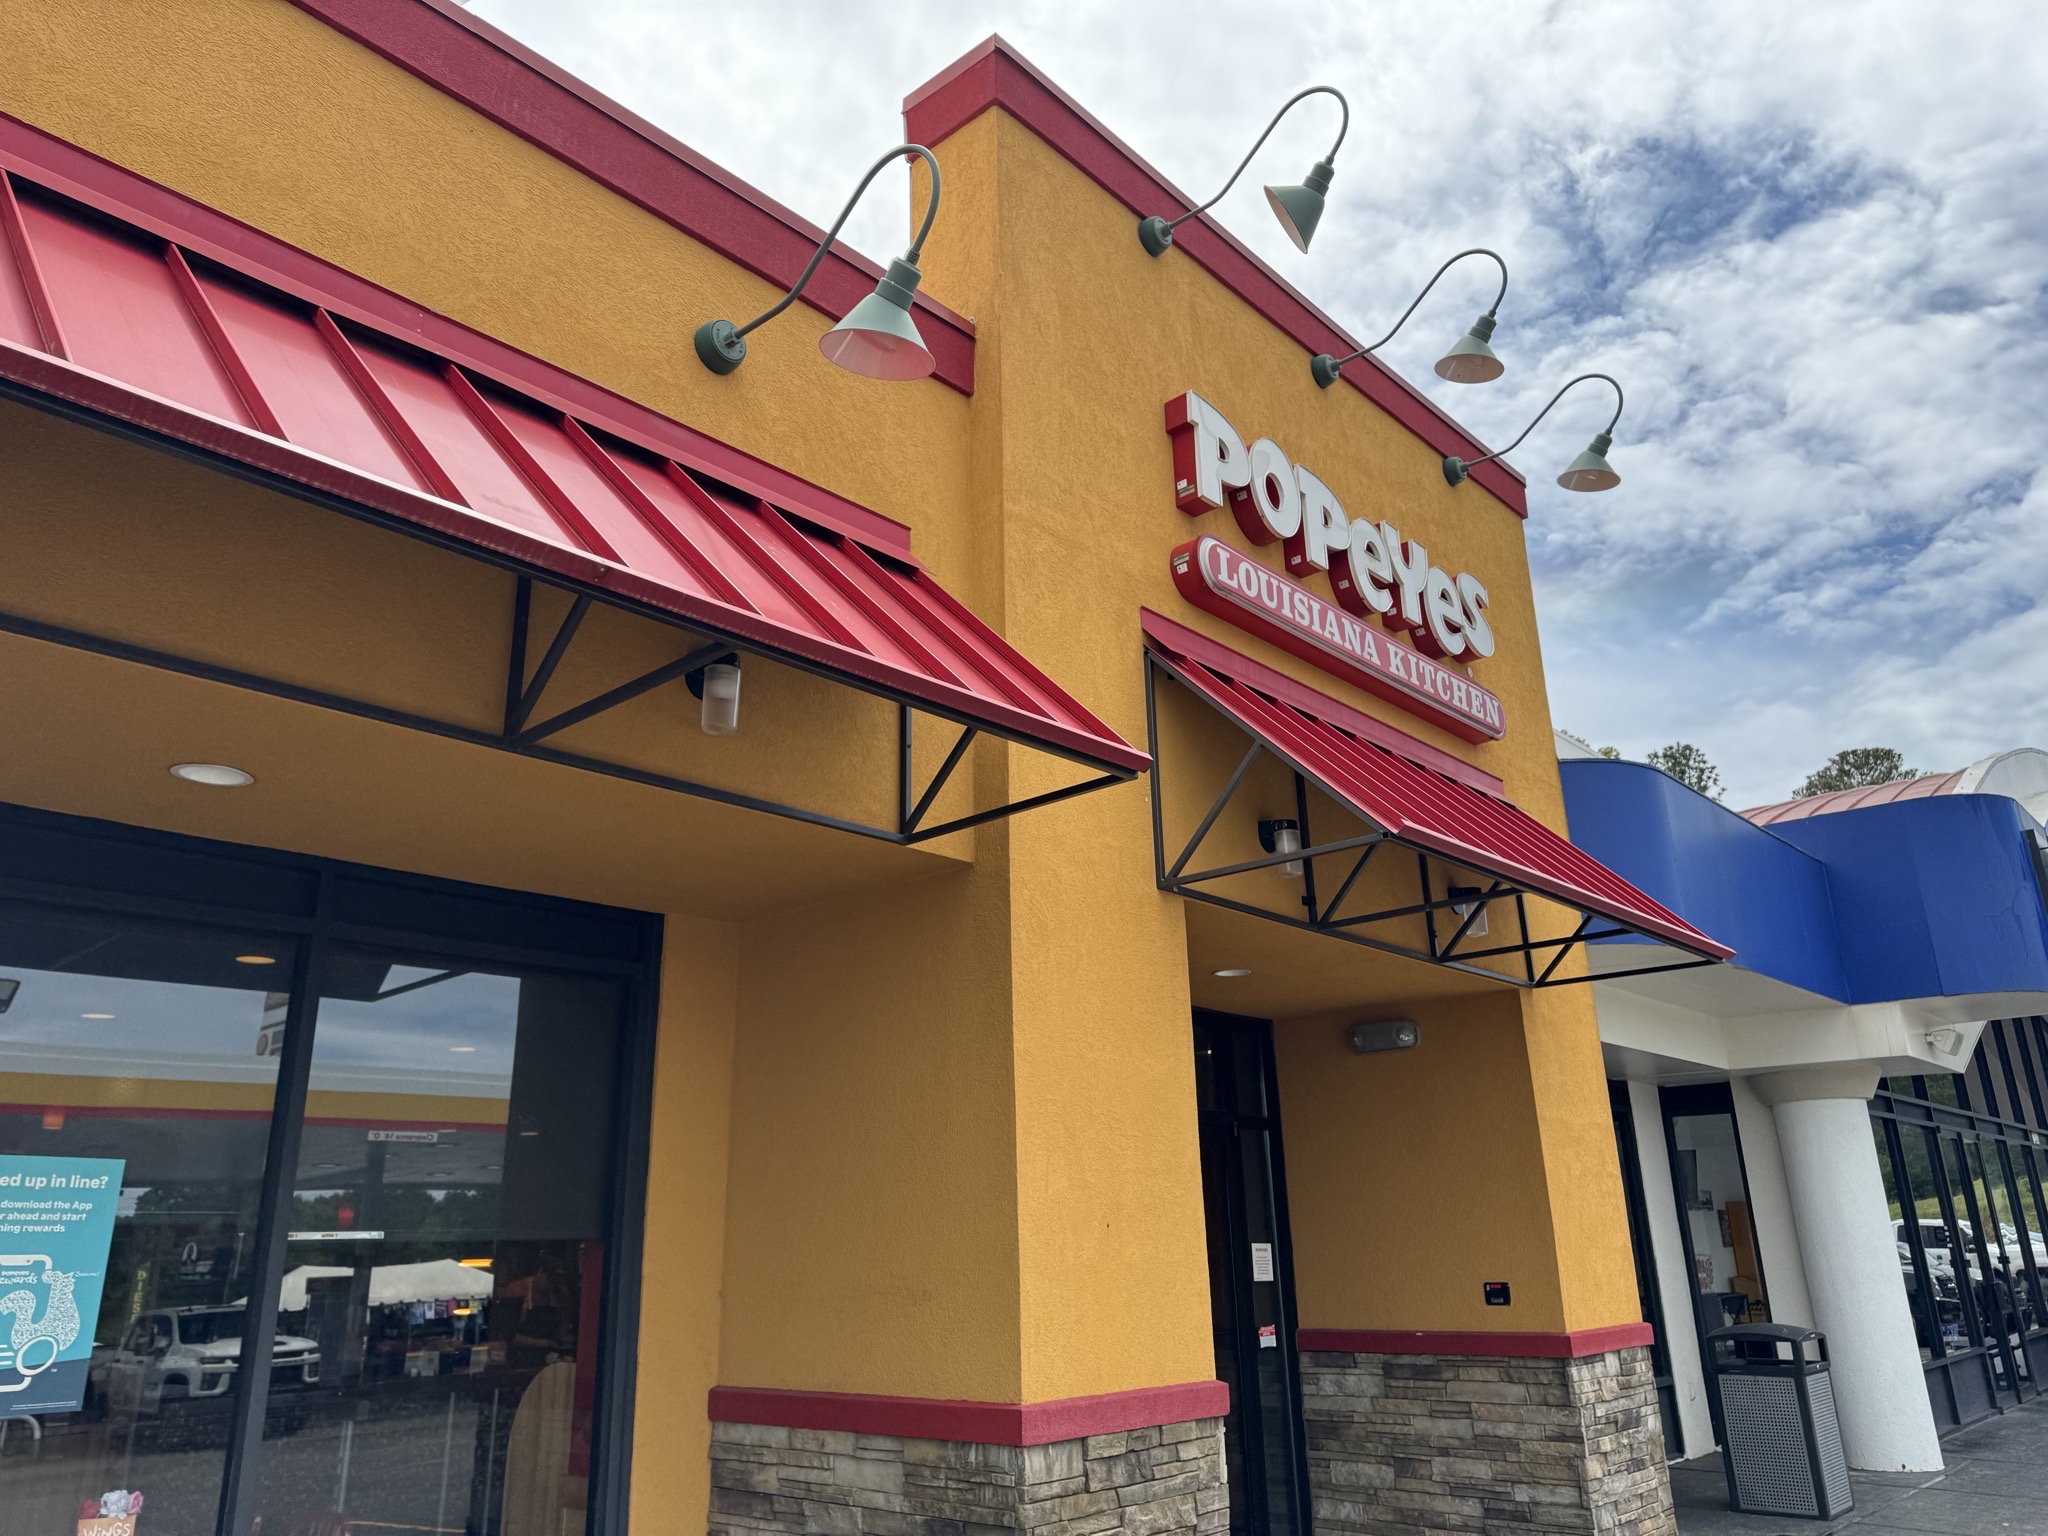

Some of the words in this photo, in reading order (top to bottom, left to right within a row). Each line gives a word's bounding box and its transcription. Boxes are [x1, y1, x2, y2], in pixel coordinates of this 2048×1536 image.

[1216, 546, 1381, 666] LOUISIANA
[1386, 642, 1500, 728] KITCHEN
[24, 1177, 47, 1190] up
[50, 1174, 66, 1188] in
[69, 1175, 109, 1189] line?
[1, 1200, 52, 1209] download
[54, 1201, 71, 1209] the
[72, 1201, 93, 1211] App
[7, 1212, 39, 1220] ahead
[40, 1212, 60, 1220] and
[61, 1213, 87, 1221] start
[22, 1224, 66, 1233] rewards
